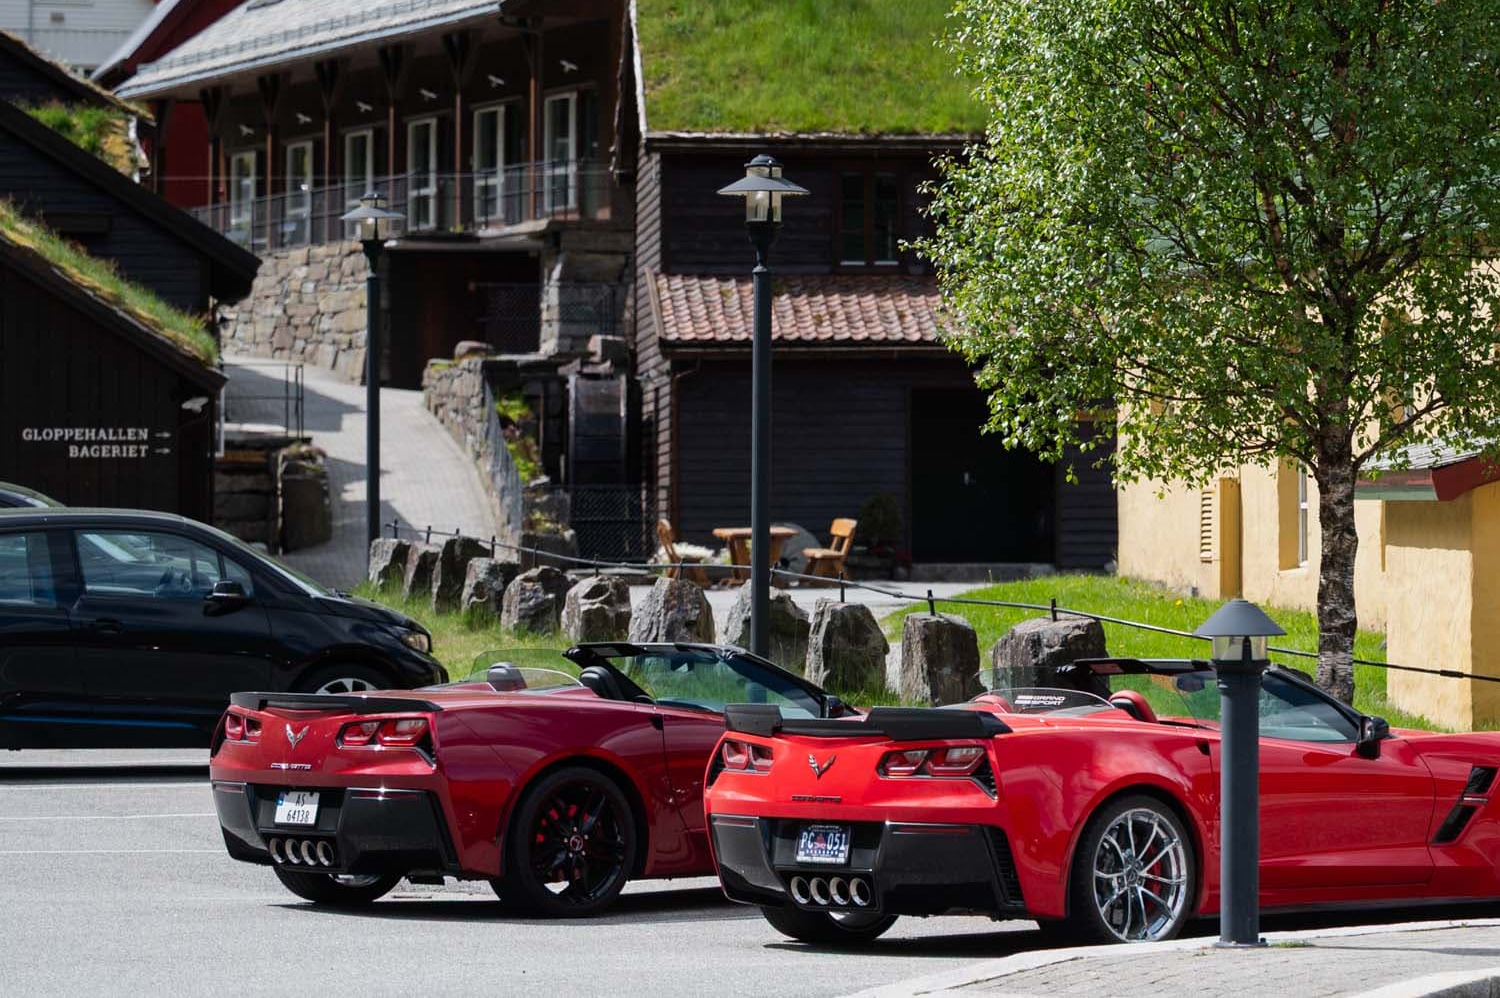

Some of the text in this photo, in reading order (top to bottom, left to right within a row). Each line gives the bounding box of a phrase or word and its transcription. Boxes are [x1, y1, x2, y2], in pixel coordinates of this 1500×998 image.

[22, 428, 149, 441] GLOPPEHALLEN
[68, 445, 149, 458] BAGERIET
[296, 793, 306, 807] AS
